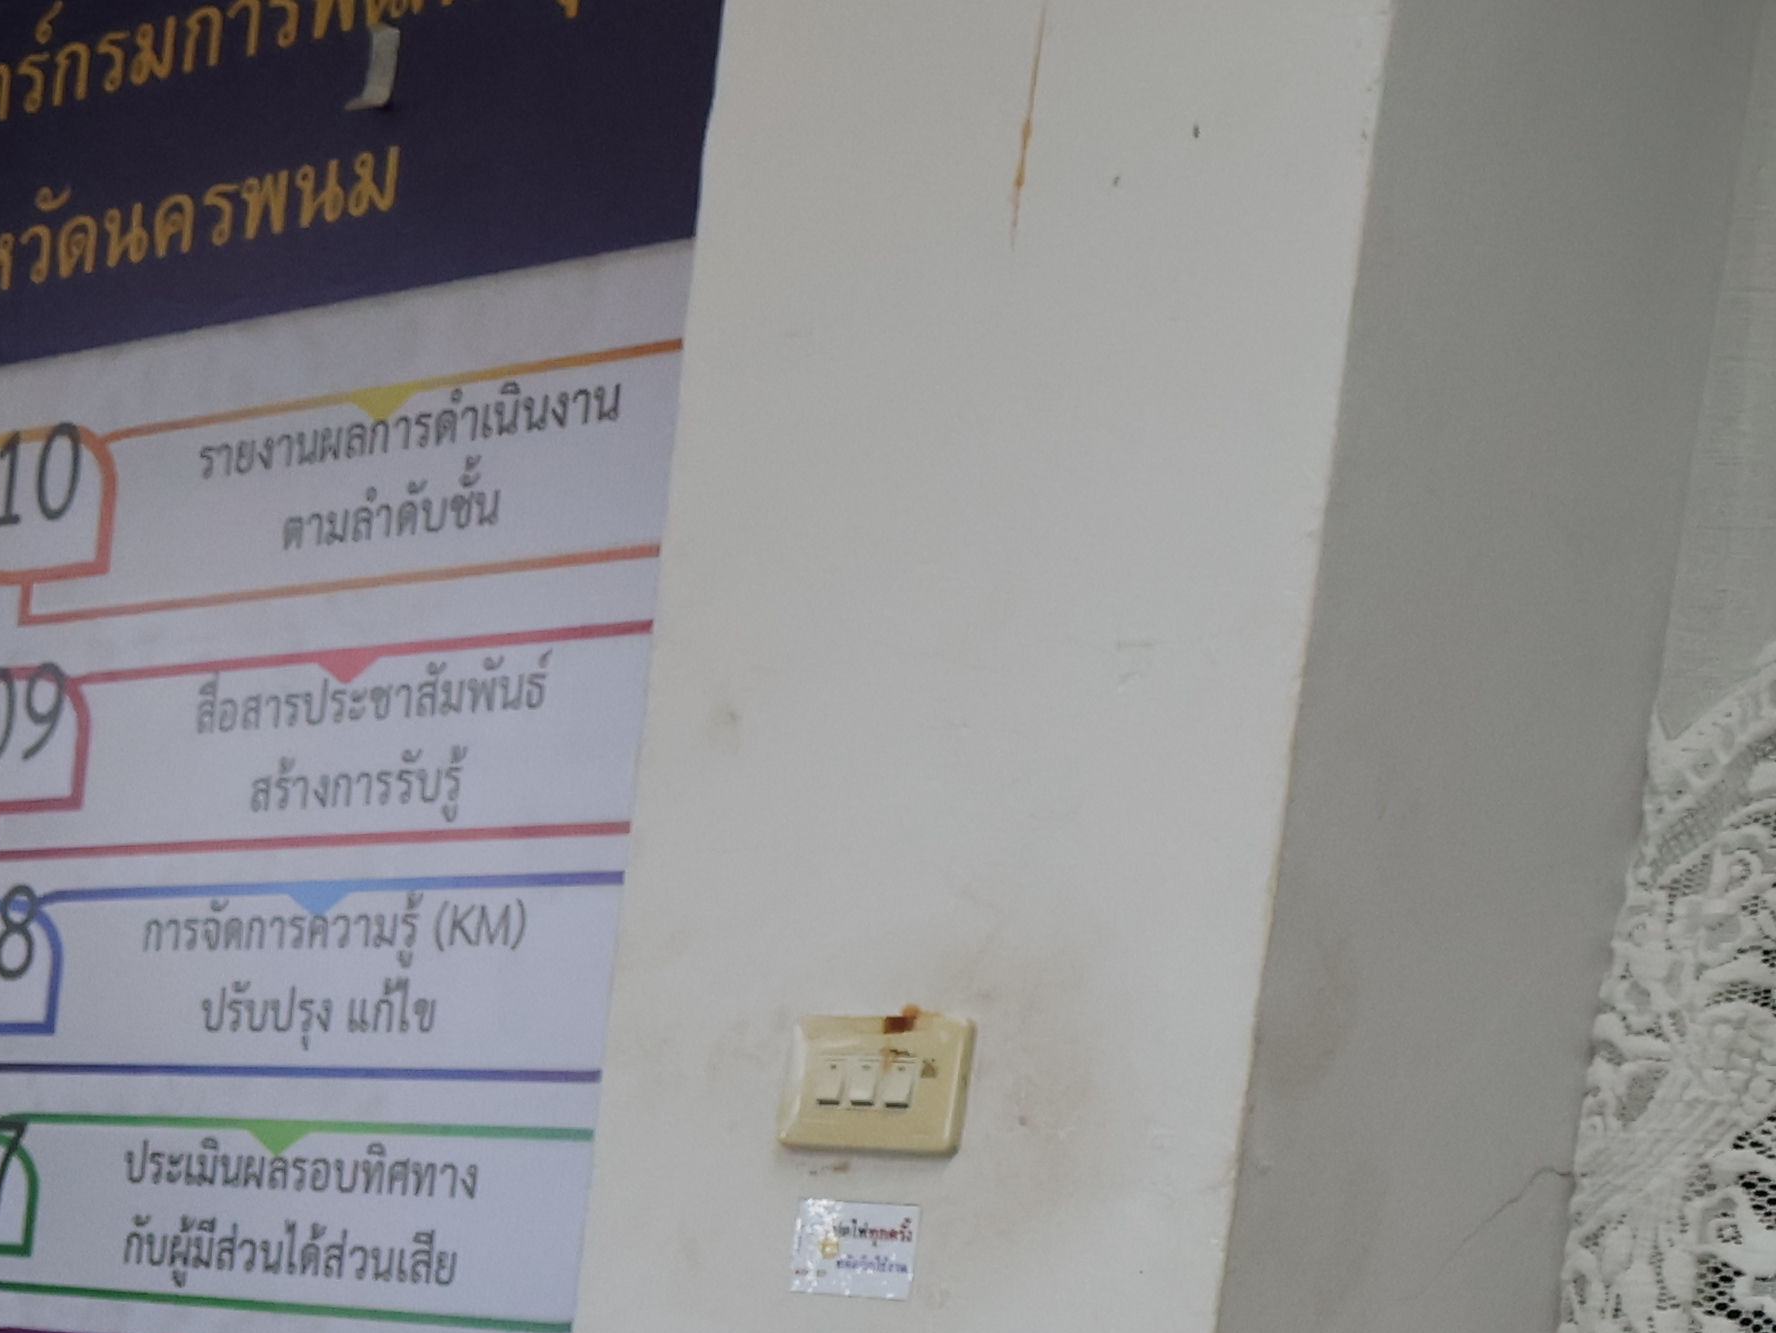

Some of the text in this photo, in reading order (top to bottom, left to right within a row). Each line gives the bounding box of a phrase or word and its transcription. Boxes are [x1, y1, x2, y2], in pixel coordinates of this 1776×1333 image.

[198, 380, 621, 481] รายงานผลการดำเนินงาน
[281, 455, 504, 550] ตามลำดับชั้น
[195, 648, 552, 735] สื่อสารประชาสัมพันธ์
[250, 745, 469, 823] สร้างการรับรู้
[142, 893, 528, 969] การจัดการความรู้ (KM)
[200, 977, 437, 1050] ปรับปรุง แก้ไข
[124, 1136, 479, 1201] ประเมินผลรอบทิศทาง
[121, 1214, 459, 1288] กับผู้มีส่วนได้ส่วนเสีย
